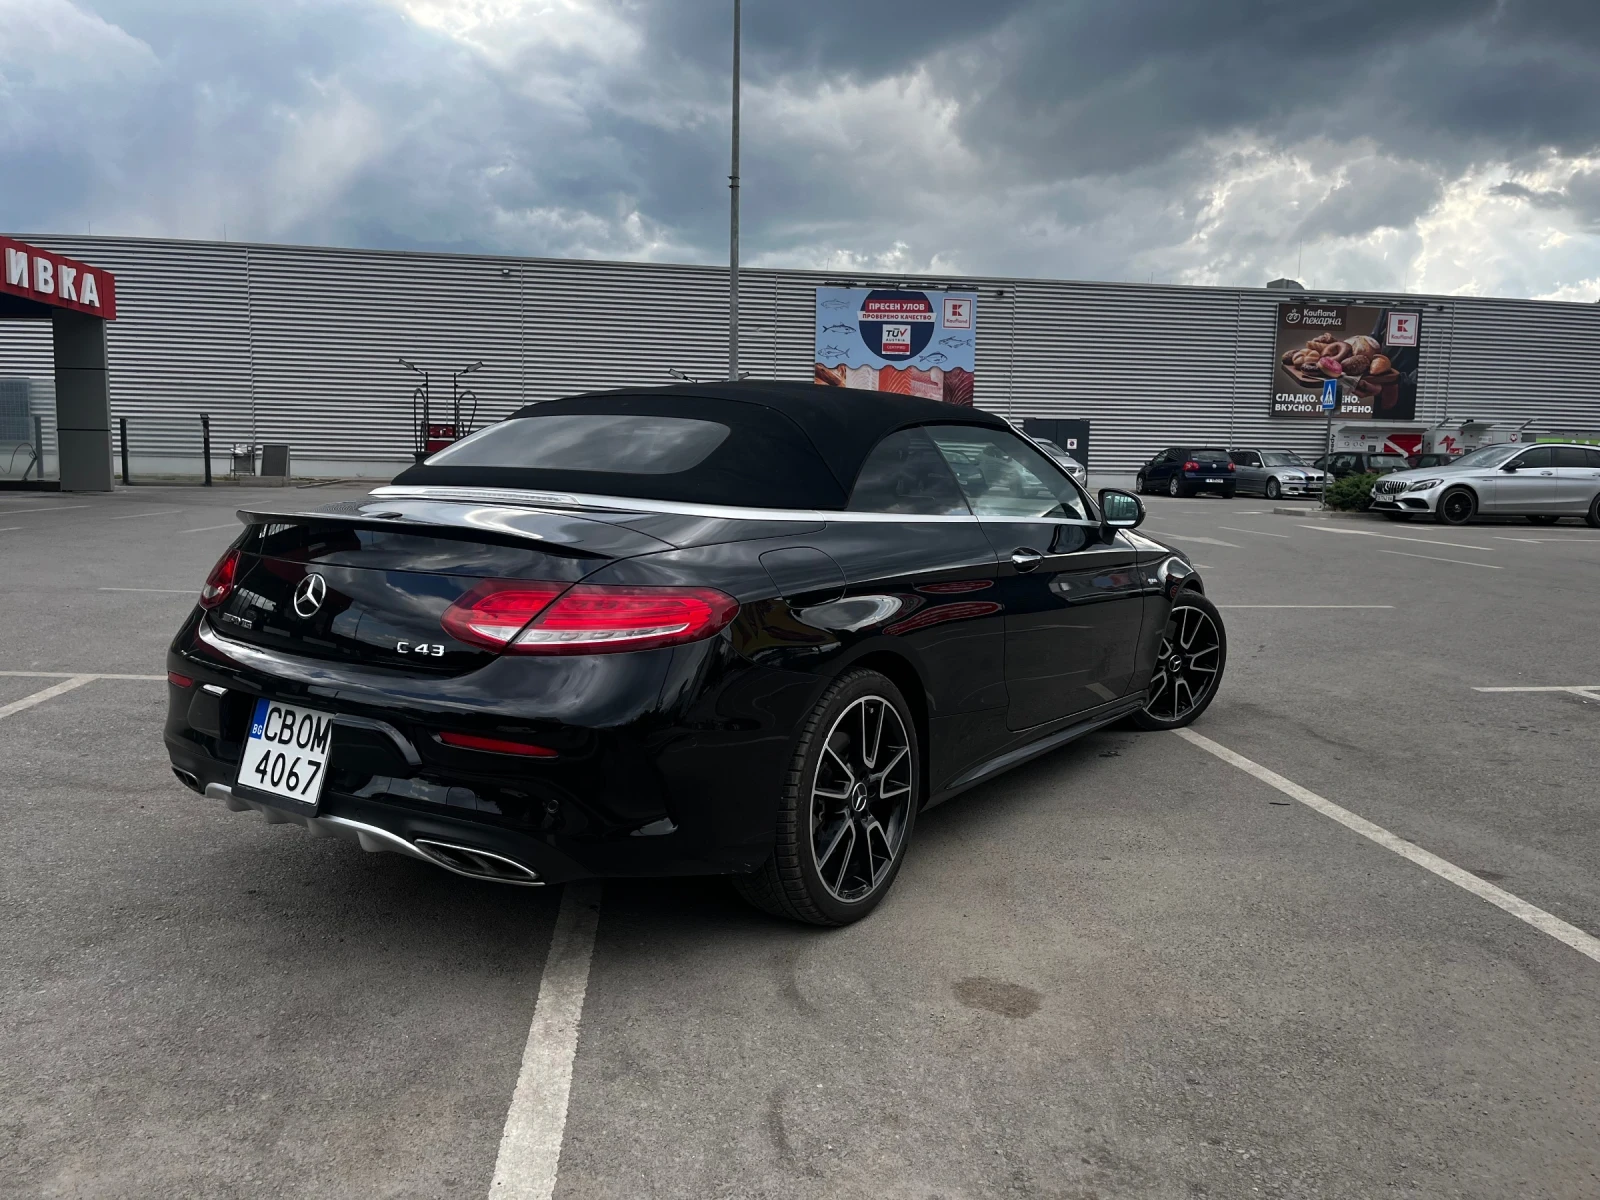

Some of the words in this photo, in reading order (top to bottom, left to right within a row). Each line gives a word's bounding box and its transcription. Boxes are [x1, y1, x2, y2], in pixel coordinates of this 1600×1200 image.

[5, 247, 100, 307] ИВКА
[868, 302, 900, 310] ПРЕСЕН
[902, 303, 925, 311] УЛОВ
[1303, 308, 1337, 317] Kaufland
[1302, 316, 1342, 327] пекарна
[886, 328, 907, 337] TÜV
[1275, 393, 1318, 403] СЛАДКО.
[1275, 403, 1314, 412] ВКУСНО.
[1315, 404, 1373, 413] ПЕРЕНО.
[397, 641, 409, 654] C
[414, 643, 445, 657] 43
[252, 724, 263, 735] BG
[254, 749, 321, 795] 4067
